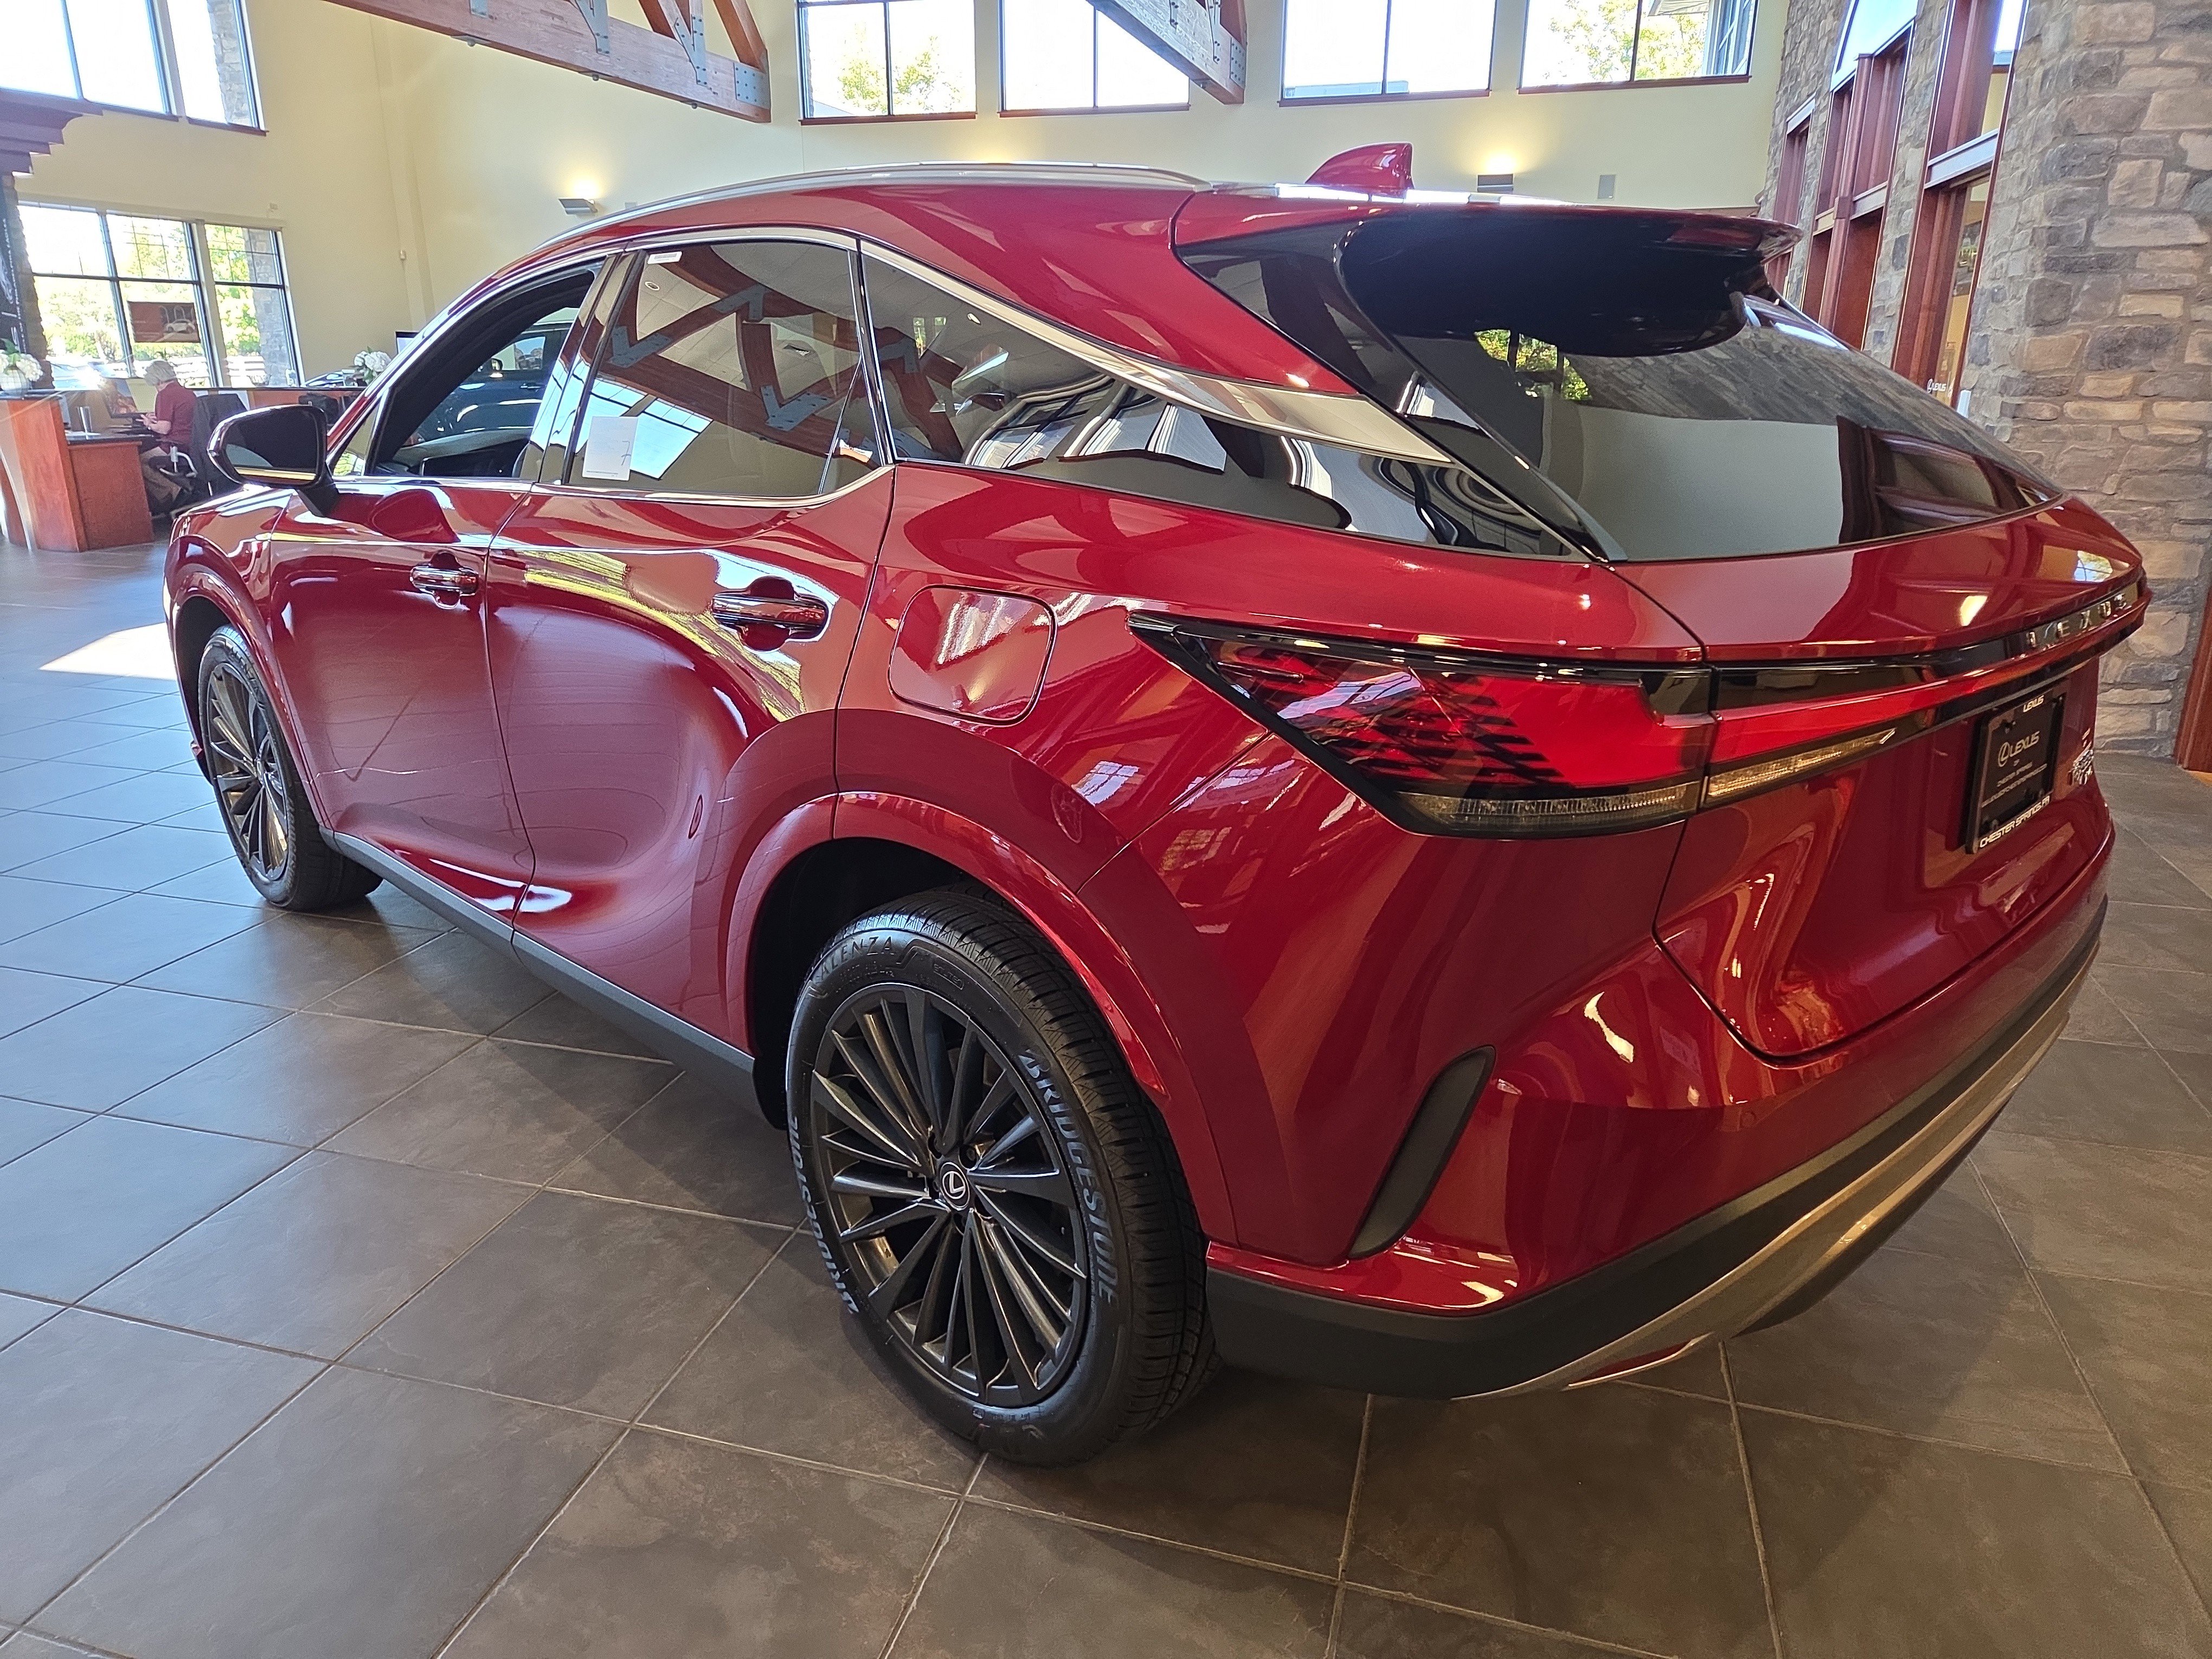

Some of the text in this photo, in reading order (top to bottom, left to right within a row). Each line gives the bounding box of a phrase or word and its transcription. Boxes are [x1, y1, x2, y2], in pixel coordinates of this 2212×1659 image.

[2023, 695, 2044, 713] LEXUS
[2009, 730, 2040, 757] LEXUS
[1979, 820, 2016, 848] CHESTER
[1018, 1050, 1119, 1304] BRIDGESTONE
